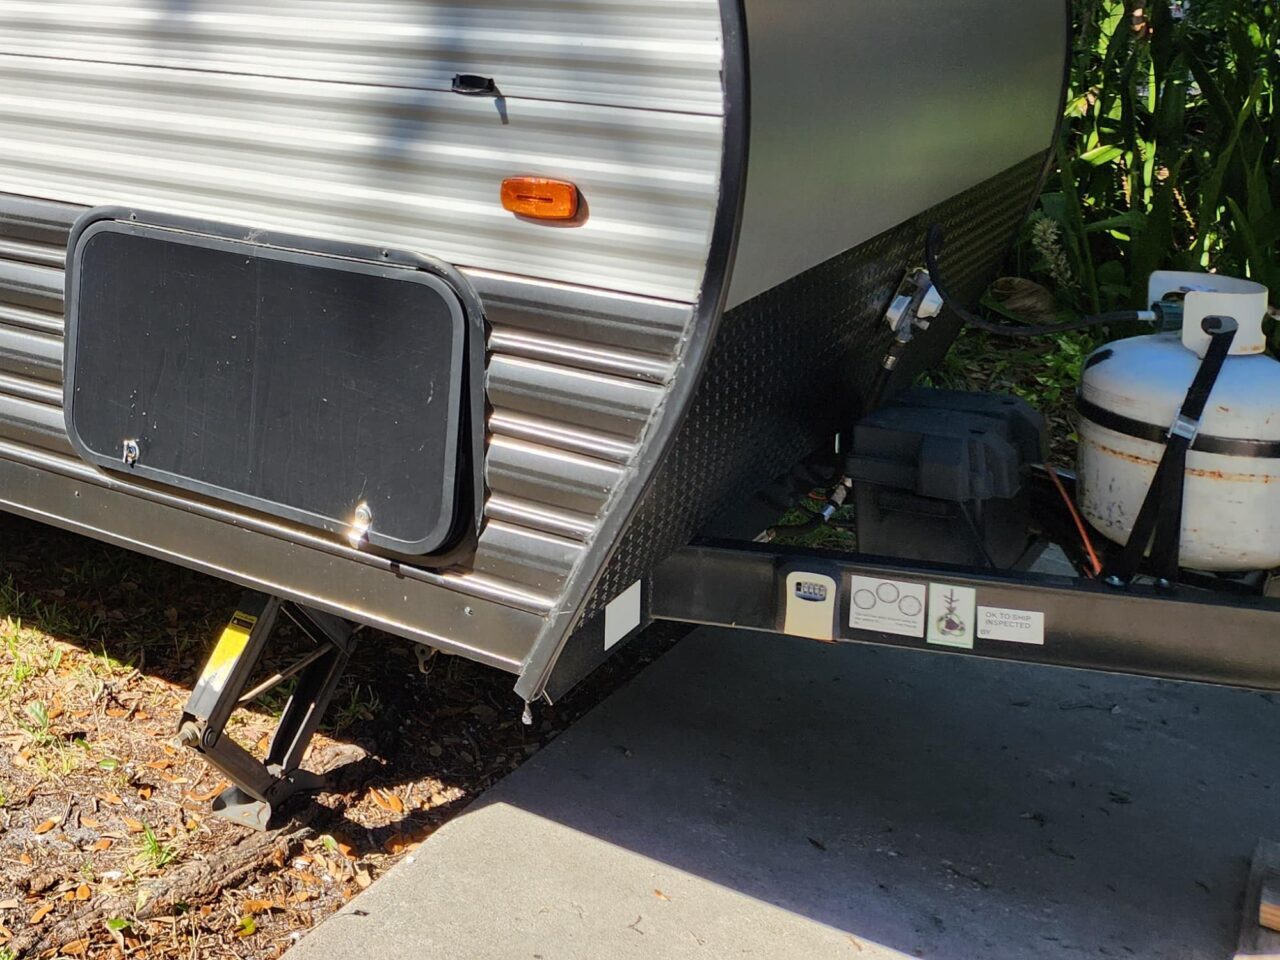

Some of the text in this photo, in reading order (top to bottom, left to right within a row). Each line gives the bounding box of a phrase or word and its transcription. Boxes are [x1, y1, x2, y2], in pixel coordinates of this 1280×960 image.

[985, 611, 1032, 622] OK TO SHIP
[985, 619, 1031, 629] INSPECTED
